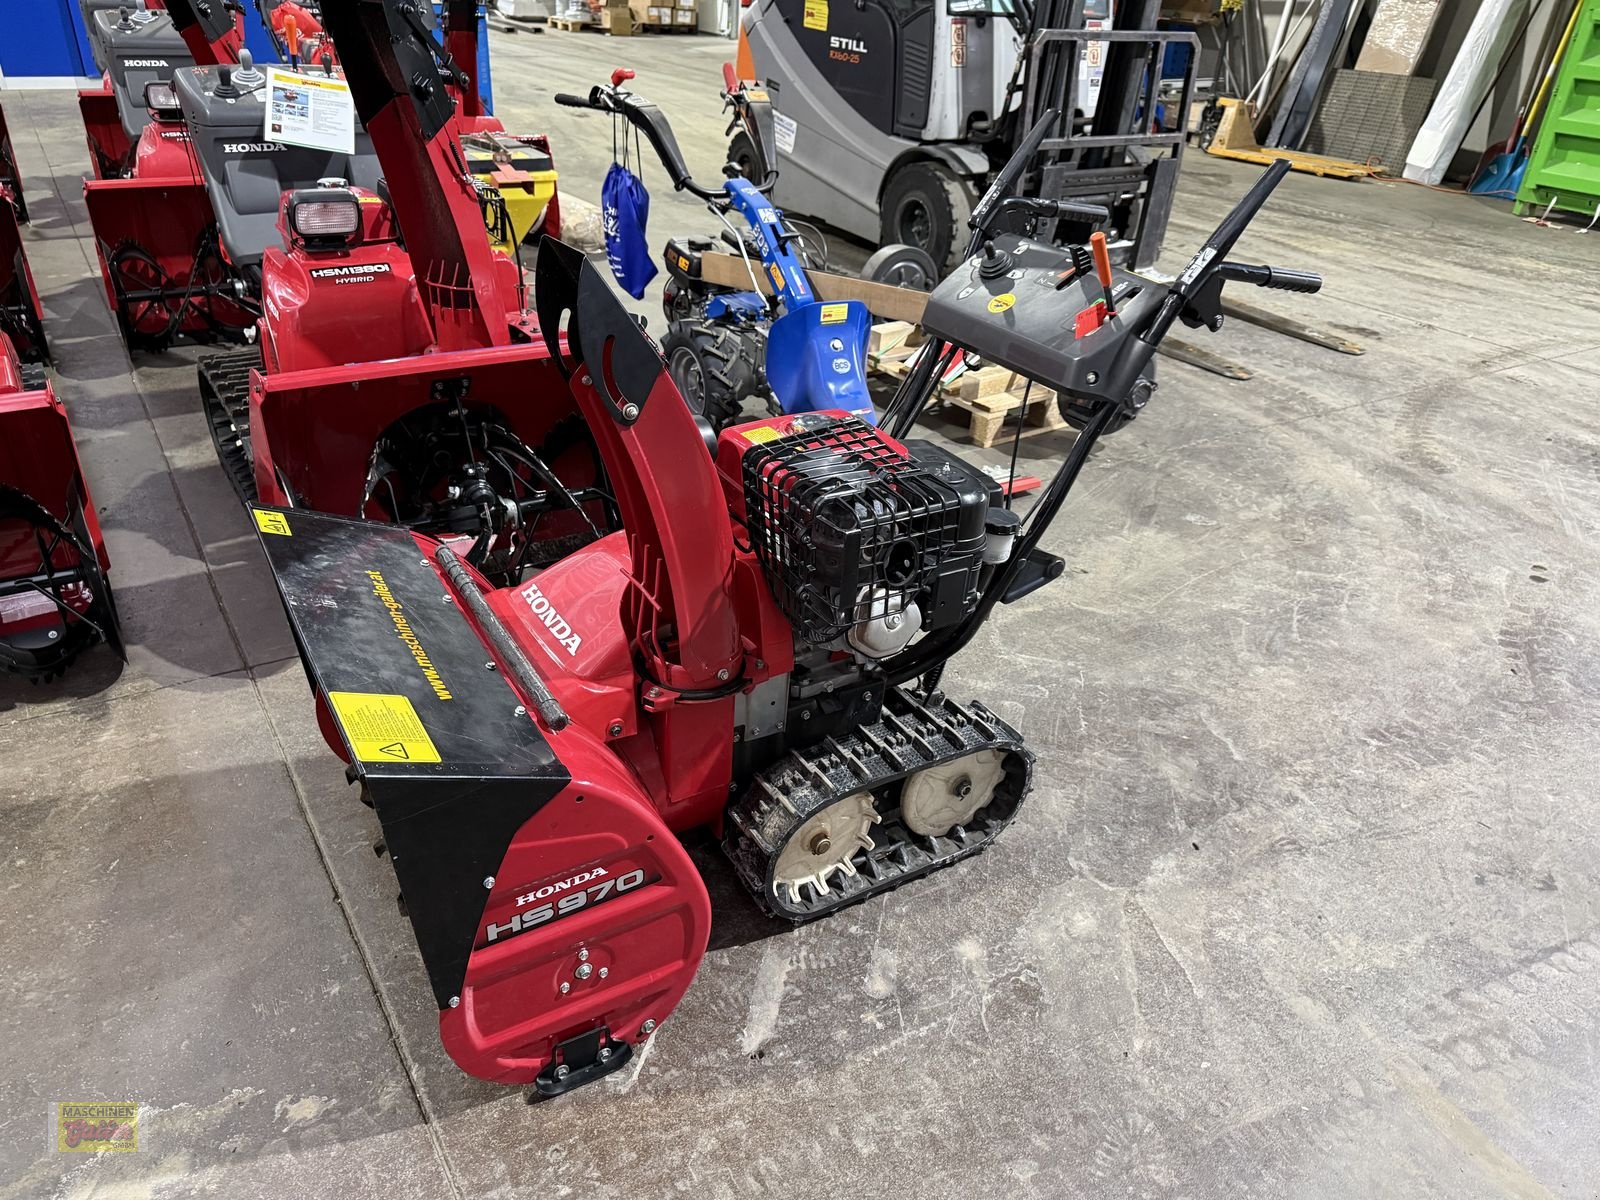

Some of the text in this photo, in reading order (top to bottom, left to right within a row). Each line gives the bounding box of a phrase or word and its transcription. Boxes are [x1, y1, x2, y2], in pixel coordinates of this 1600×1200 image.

[830, 36, 868, 53] STILL
[223, 143, 288, 153] HONDA
[335, 275, 375, 285] HYBRID
[834, 361, 849, 370] BCS
[364, 569, 453, 700] www.maschinen-gailer.at
[521, 583, 582, 657] HONDA
[515, 866, 609, 907] HONDA
[486, 868, 645, 943] HS970
